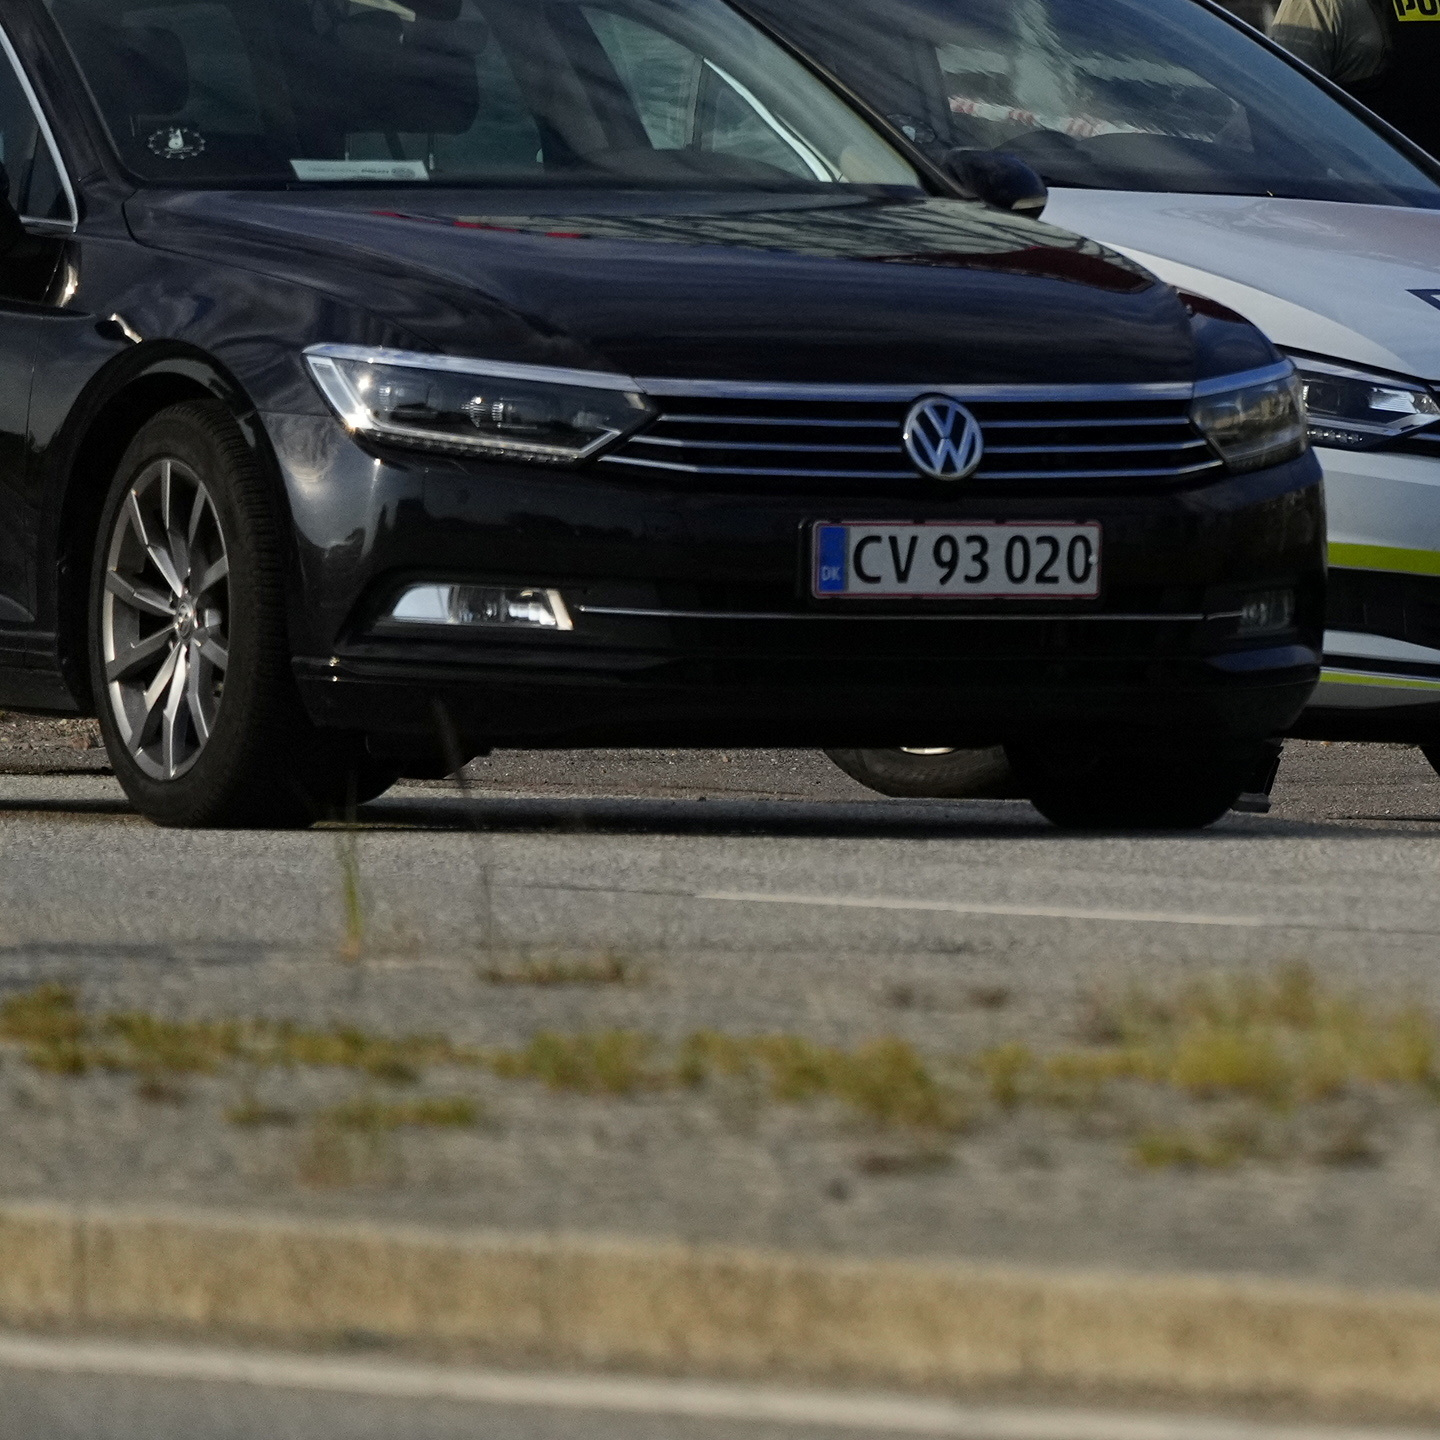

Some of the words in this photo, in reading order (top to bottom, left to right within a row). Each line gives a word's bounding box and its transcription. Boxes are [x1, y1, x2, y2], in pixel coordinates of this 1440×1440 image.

[821, 565, 842, 582] DK
[852, 534, 919, 585] CV
[933, 534, 990, 586] 93
[1005, 534, 1093, 585] 020
